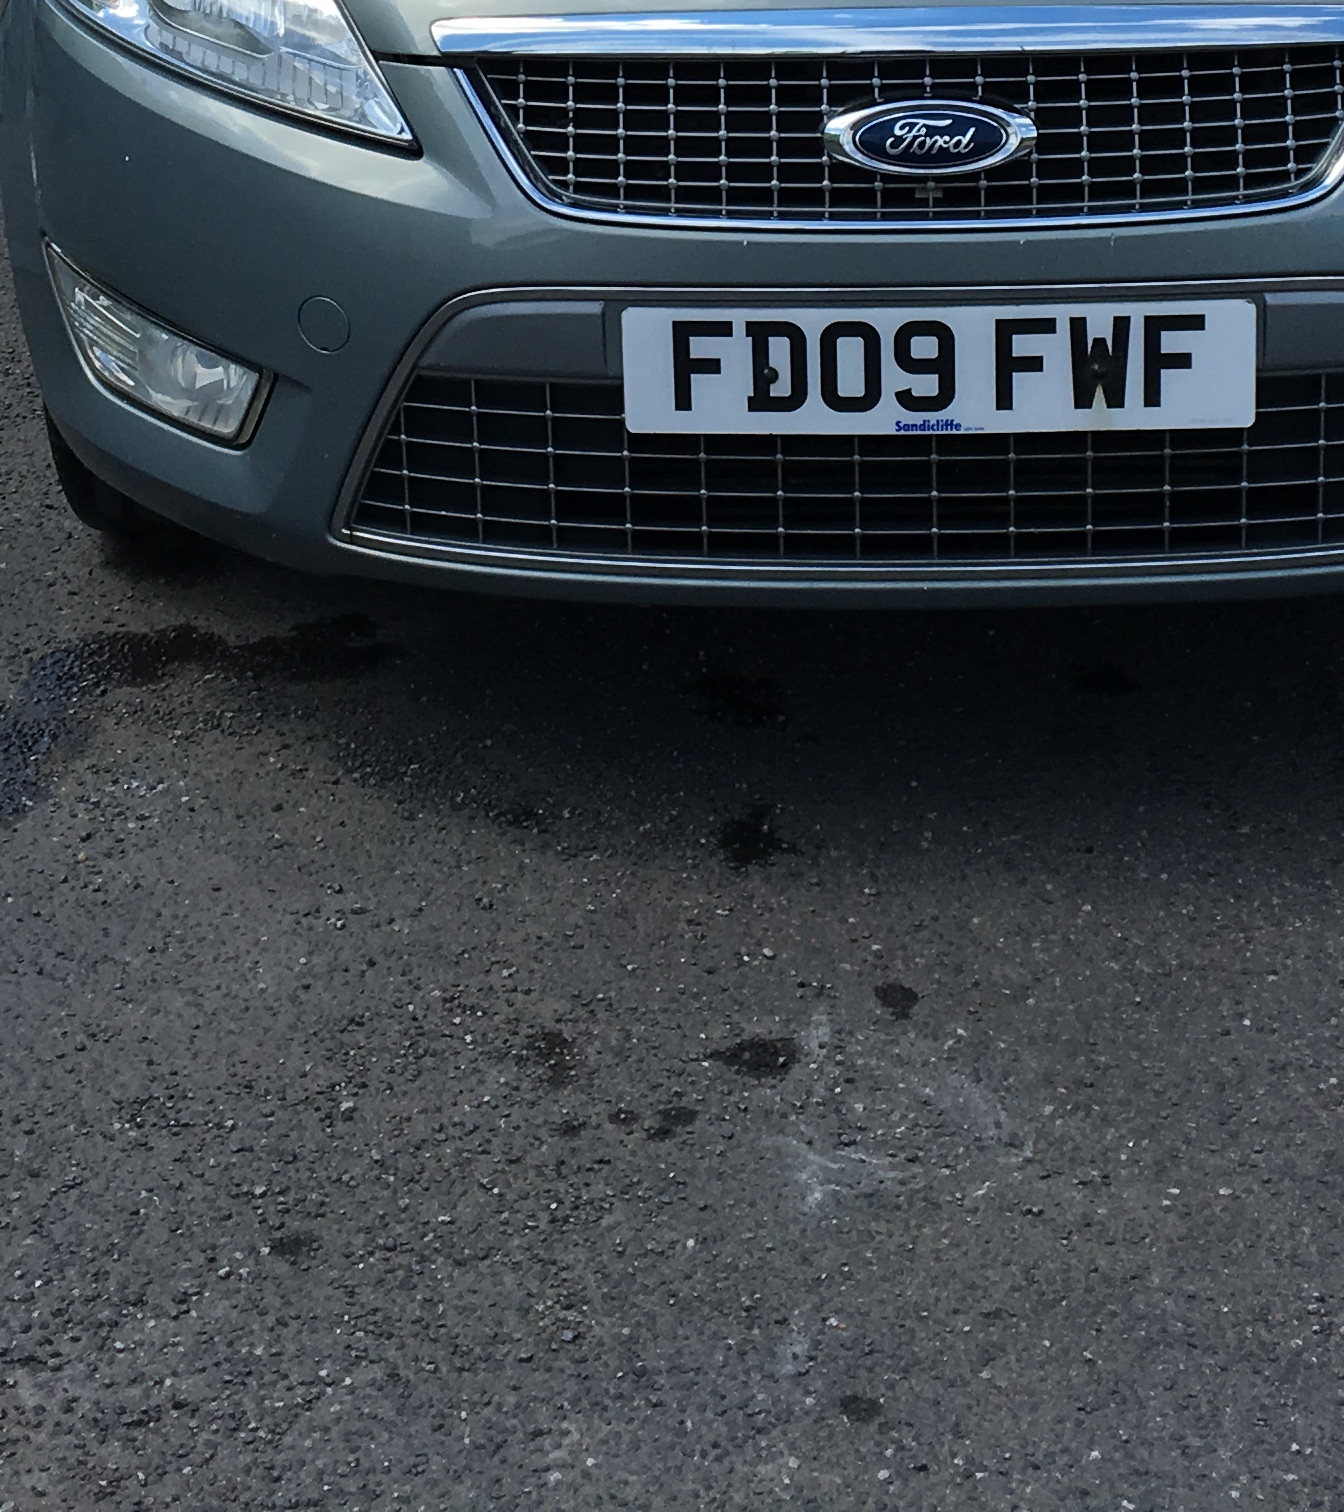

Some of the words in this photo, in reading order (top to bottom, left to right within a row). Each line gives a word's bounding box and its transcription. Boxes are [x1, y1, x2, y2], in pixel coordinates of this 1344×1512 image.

[885, 118, 977, 156] Ford
[672, 320, 956, 413] FD09
[994, 314, 1206, 411] FWF
[895, 419, 962, 432] Sandicliffe
